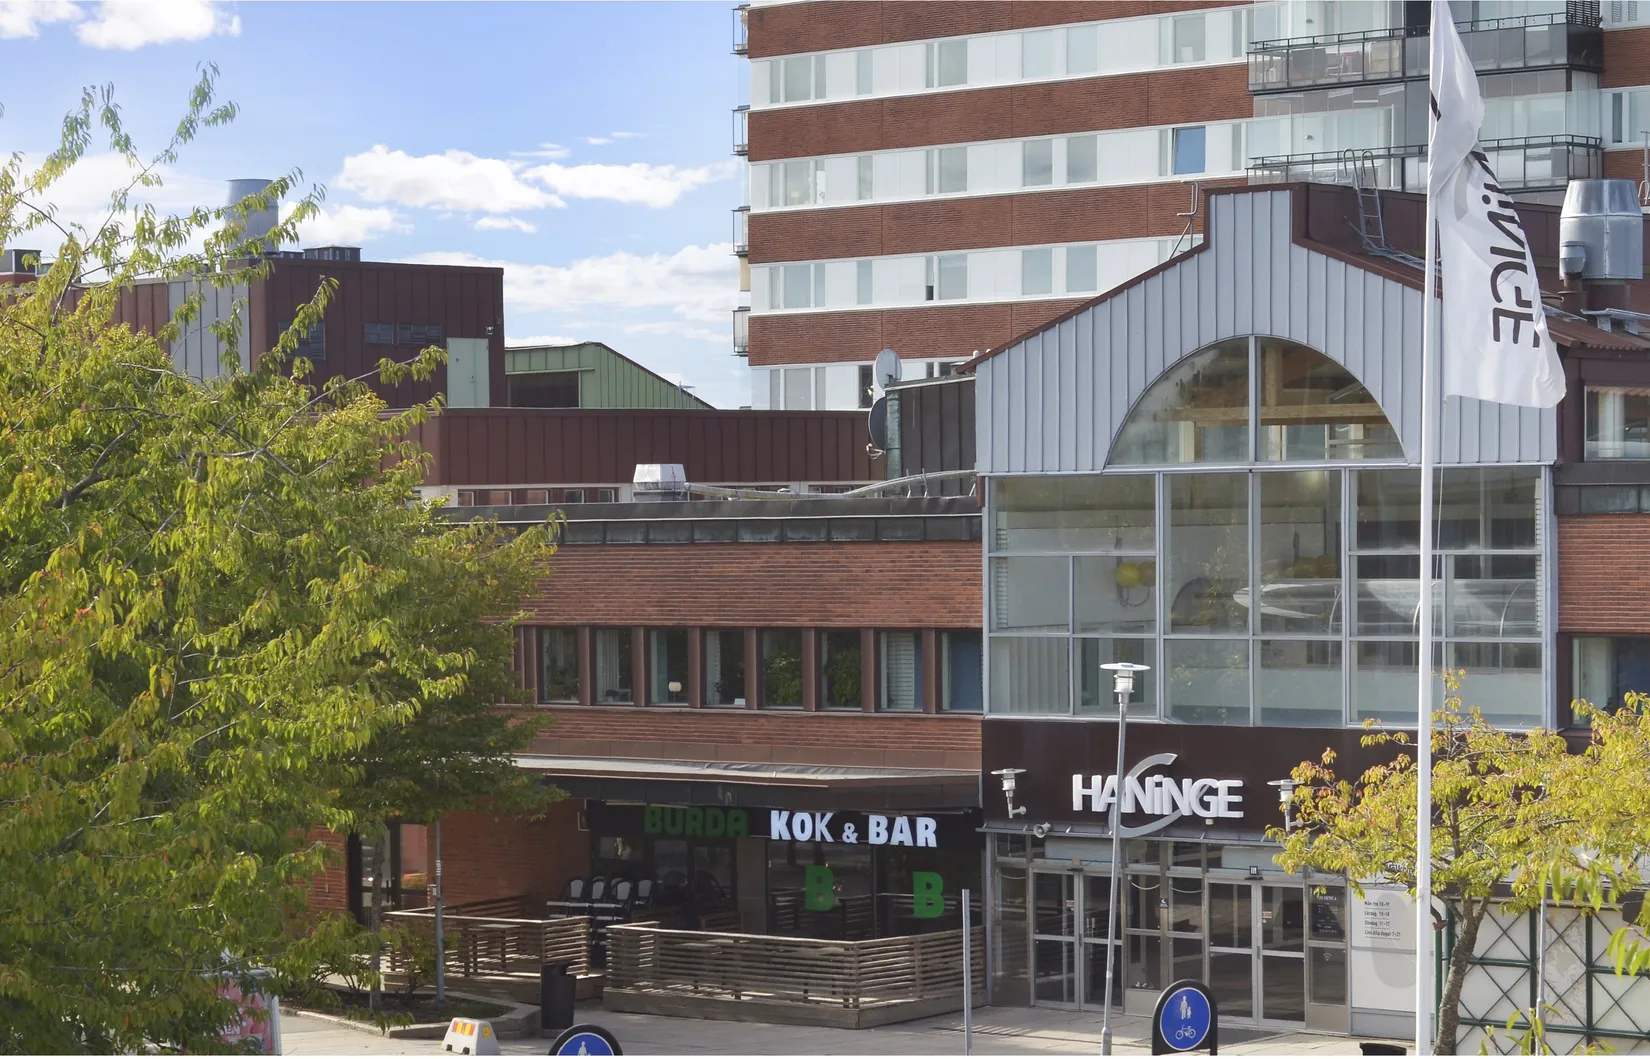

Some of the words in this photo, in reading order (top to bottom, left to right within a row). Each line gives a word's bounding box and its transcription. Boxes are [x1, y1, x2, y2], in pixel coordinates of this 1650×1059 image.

[644, 805, 748, 838] BURDA
[770, 809, 834, 843] KOK
[842, 823, 858, 845] &
[868, 815, 938, 848] BAR
[804, 865, 836, 912] B
[912, 871, 945, 919] B
